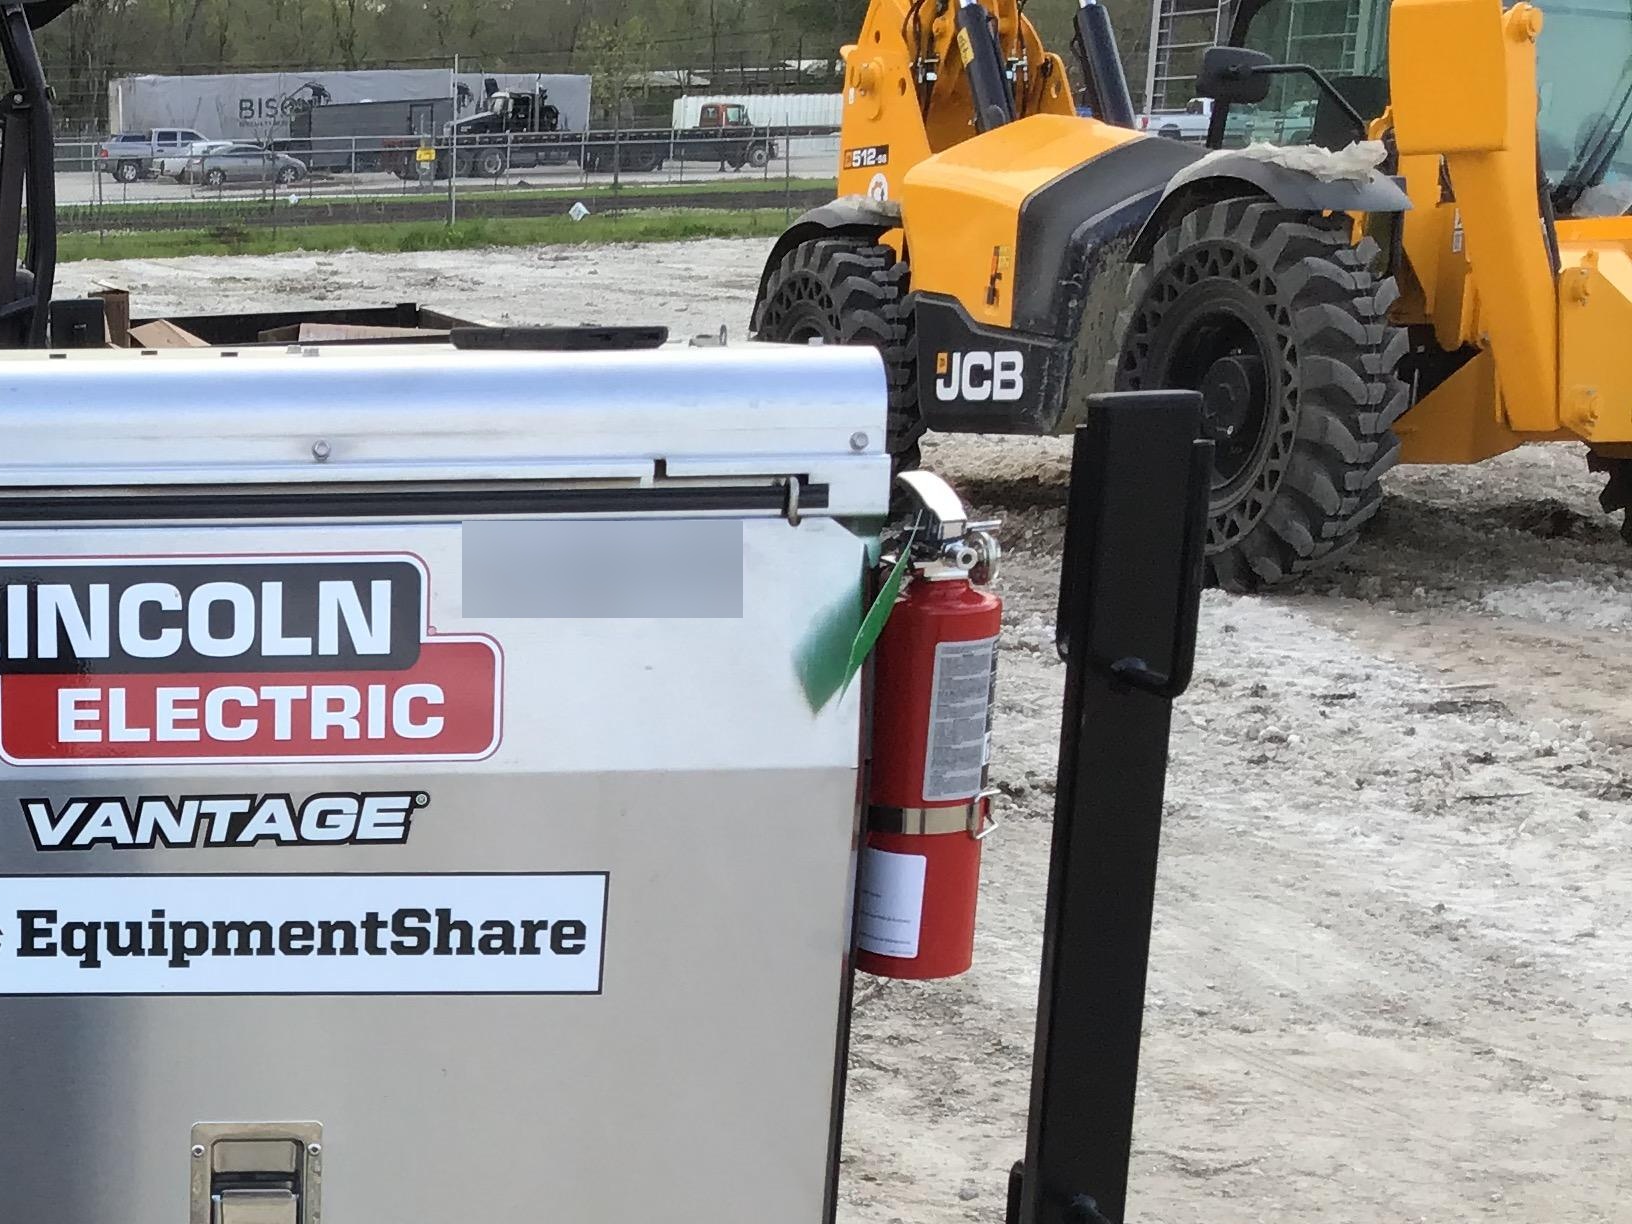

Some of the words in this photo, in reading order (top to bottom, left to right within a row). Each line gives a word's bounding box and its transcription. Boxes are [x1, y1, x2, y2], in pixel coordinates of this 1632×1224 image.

[239, 98, 311, 119] BISO
[936, 351, 1023, 401] JCB
[58, 683, 445, 743] ELECTRIC
[23, 794, 413, 849] VANTAGE
[16, 908, 587, 969] EquipmentShare
